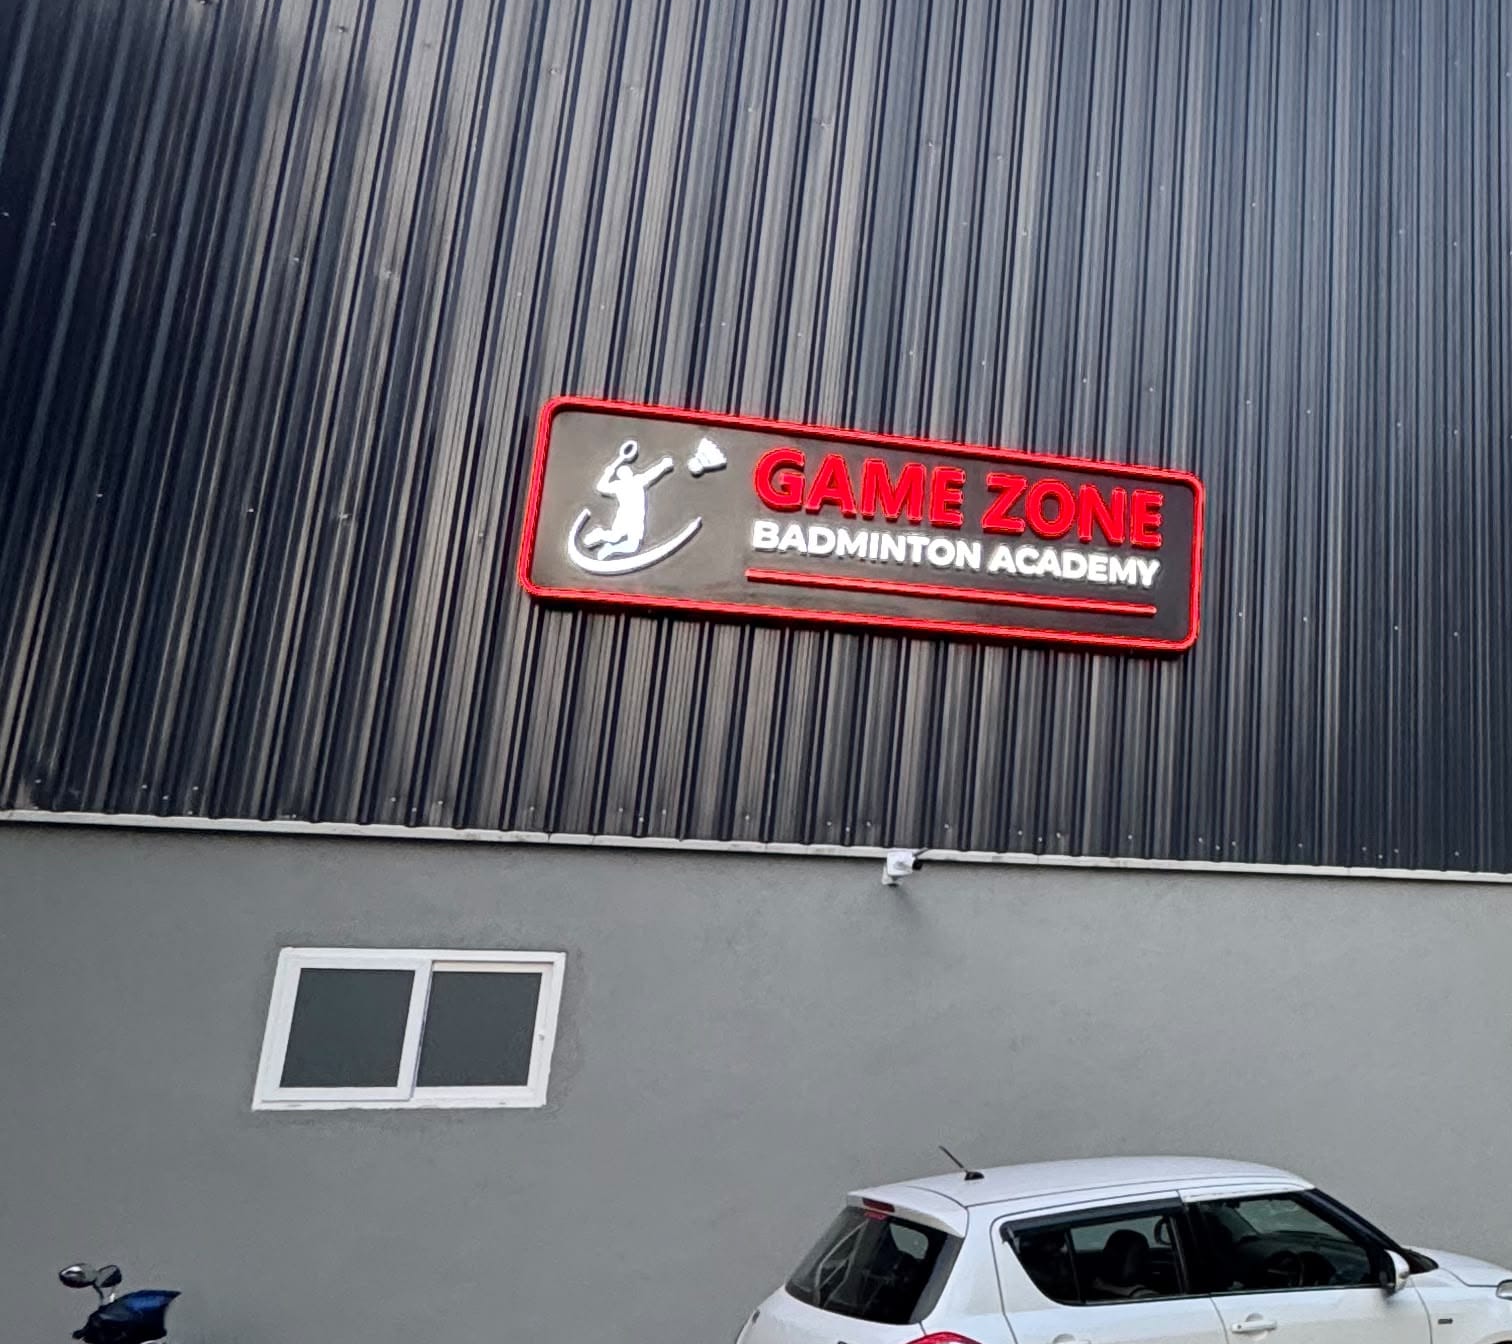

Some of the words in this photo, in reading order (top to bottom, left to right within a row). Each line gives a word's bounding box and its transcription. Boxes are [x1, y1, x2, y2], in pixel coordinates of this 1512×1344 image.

[754, 448, 966, 527] GAME
[982, 472, 1163, 546] ZONE
[753, 520, 981, 569] BADMINTON
[988, 544, 1160, 587] ACADEMY
